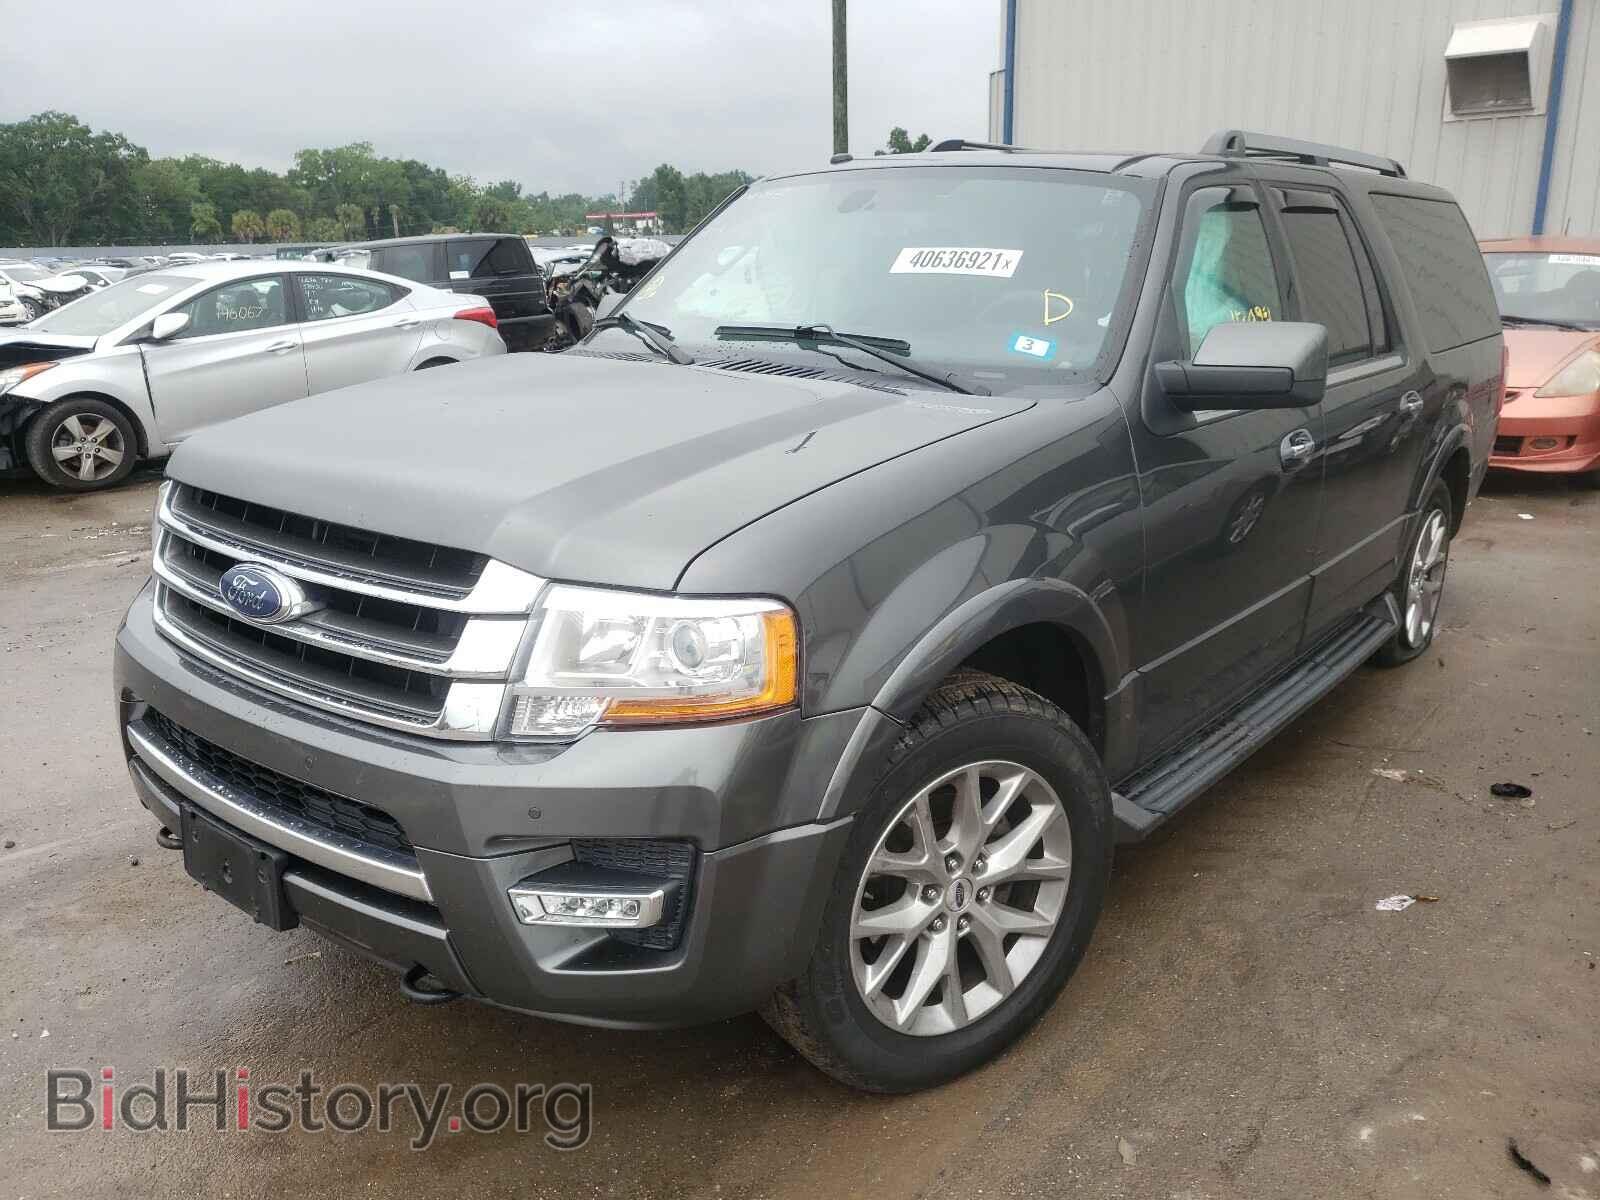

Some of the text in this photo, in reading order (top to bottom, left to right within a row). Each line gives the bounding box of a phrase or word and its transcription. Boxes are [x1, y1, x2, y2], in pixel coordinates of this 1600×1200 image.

[1043, 288, 1074, 326] D
[1022, 338, 1035, 351] 3
[227, 573, 269, 610] Ford
